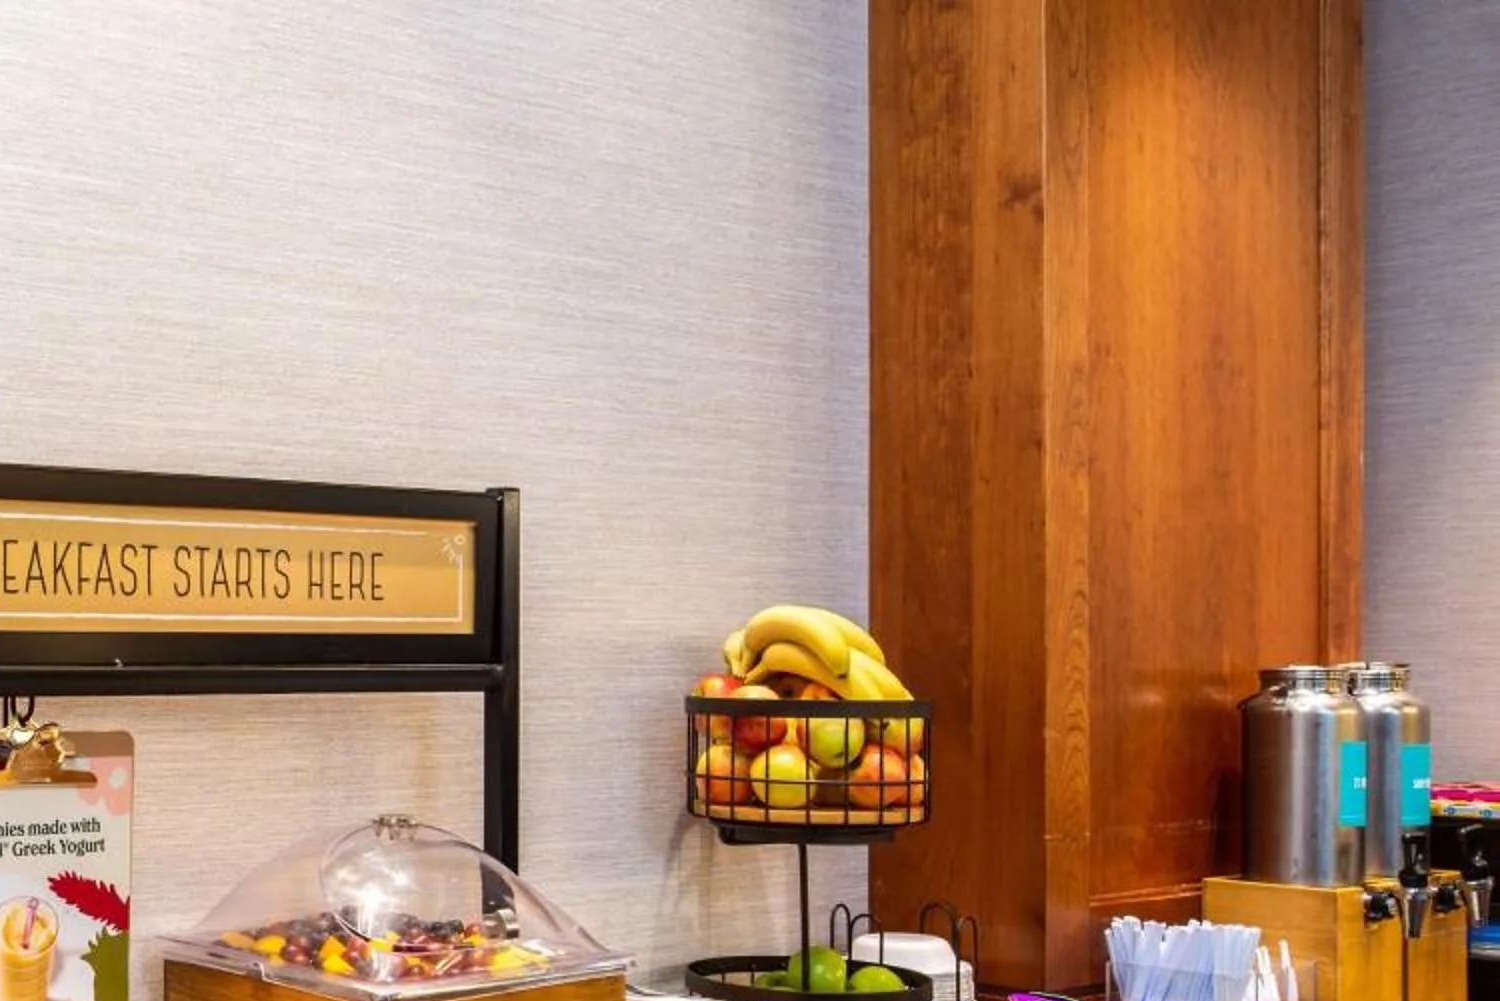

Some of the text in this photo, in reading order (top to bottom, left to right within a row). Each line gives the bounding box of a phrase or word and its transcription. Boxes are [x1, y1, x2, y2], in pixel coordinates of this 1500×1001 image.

[173, 544, 292, 599] STARTS
[307, 550, 386, 601] HERE
[27, 819, 68, 836] made
[70, 817, 101, 834] with
[12, 839, 56, 857] Greek
[59, 838, 106, 857] Yogurt
